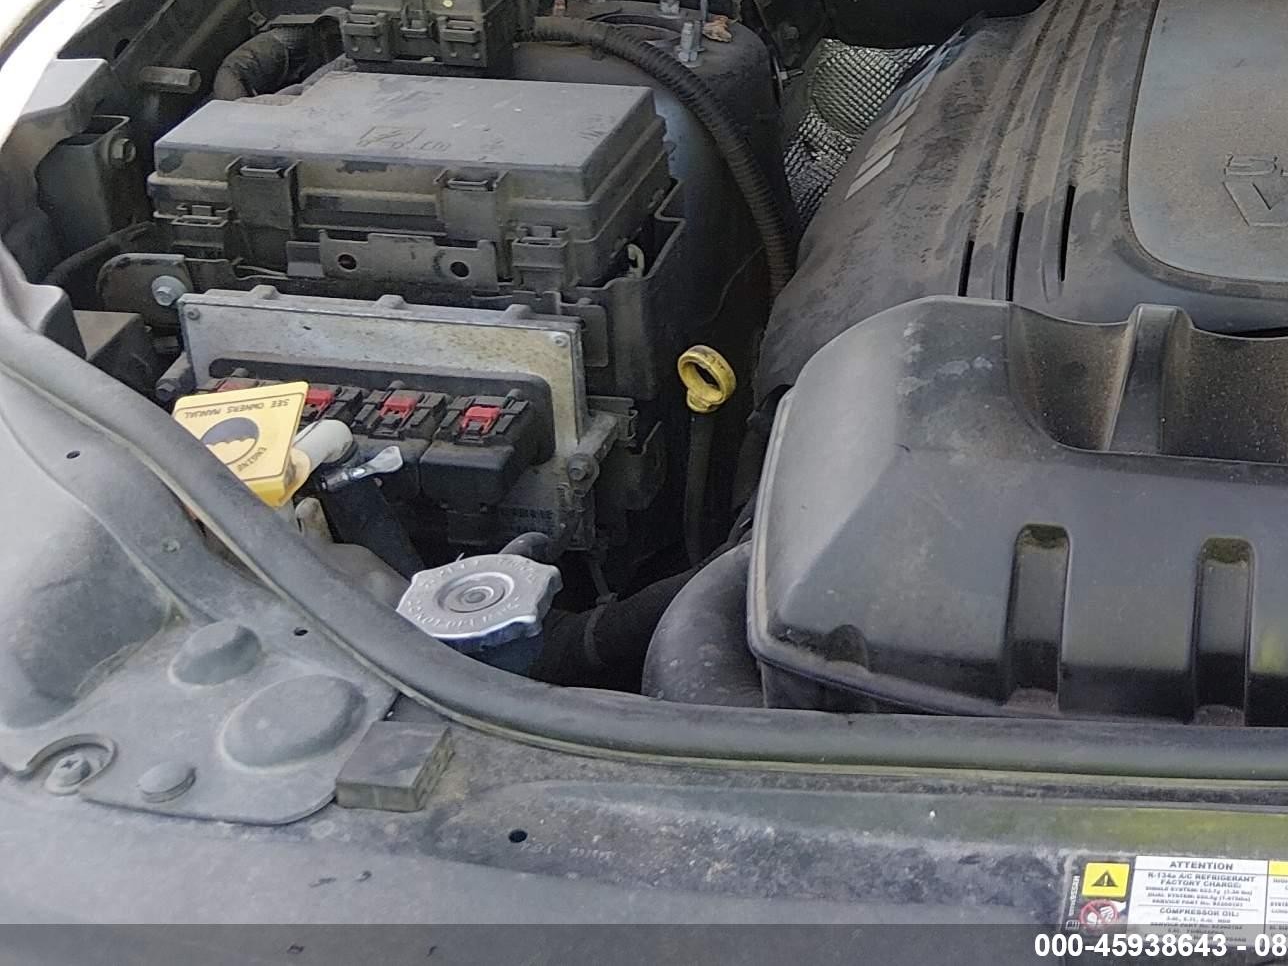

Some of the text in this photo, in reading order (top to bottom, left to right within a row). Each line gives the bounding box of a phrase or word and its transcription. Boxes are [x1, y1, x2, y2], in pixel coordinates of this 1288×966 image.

[271, 398, 290, 408] SEE
[184, 408, 222, 419] MANUAL
[1169, 860, 1234, 871] ATTENTION
[1195, 874, 1256, 883] REFRIGERANT
[1159, 907, 1220, 916] COMPRESSOR
